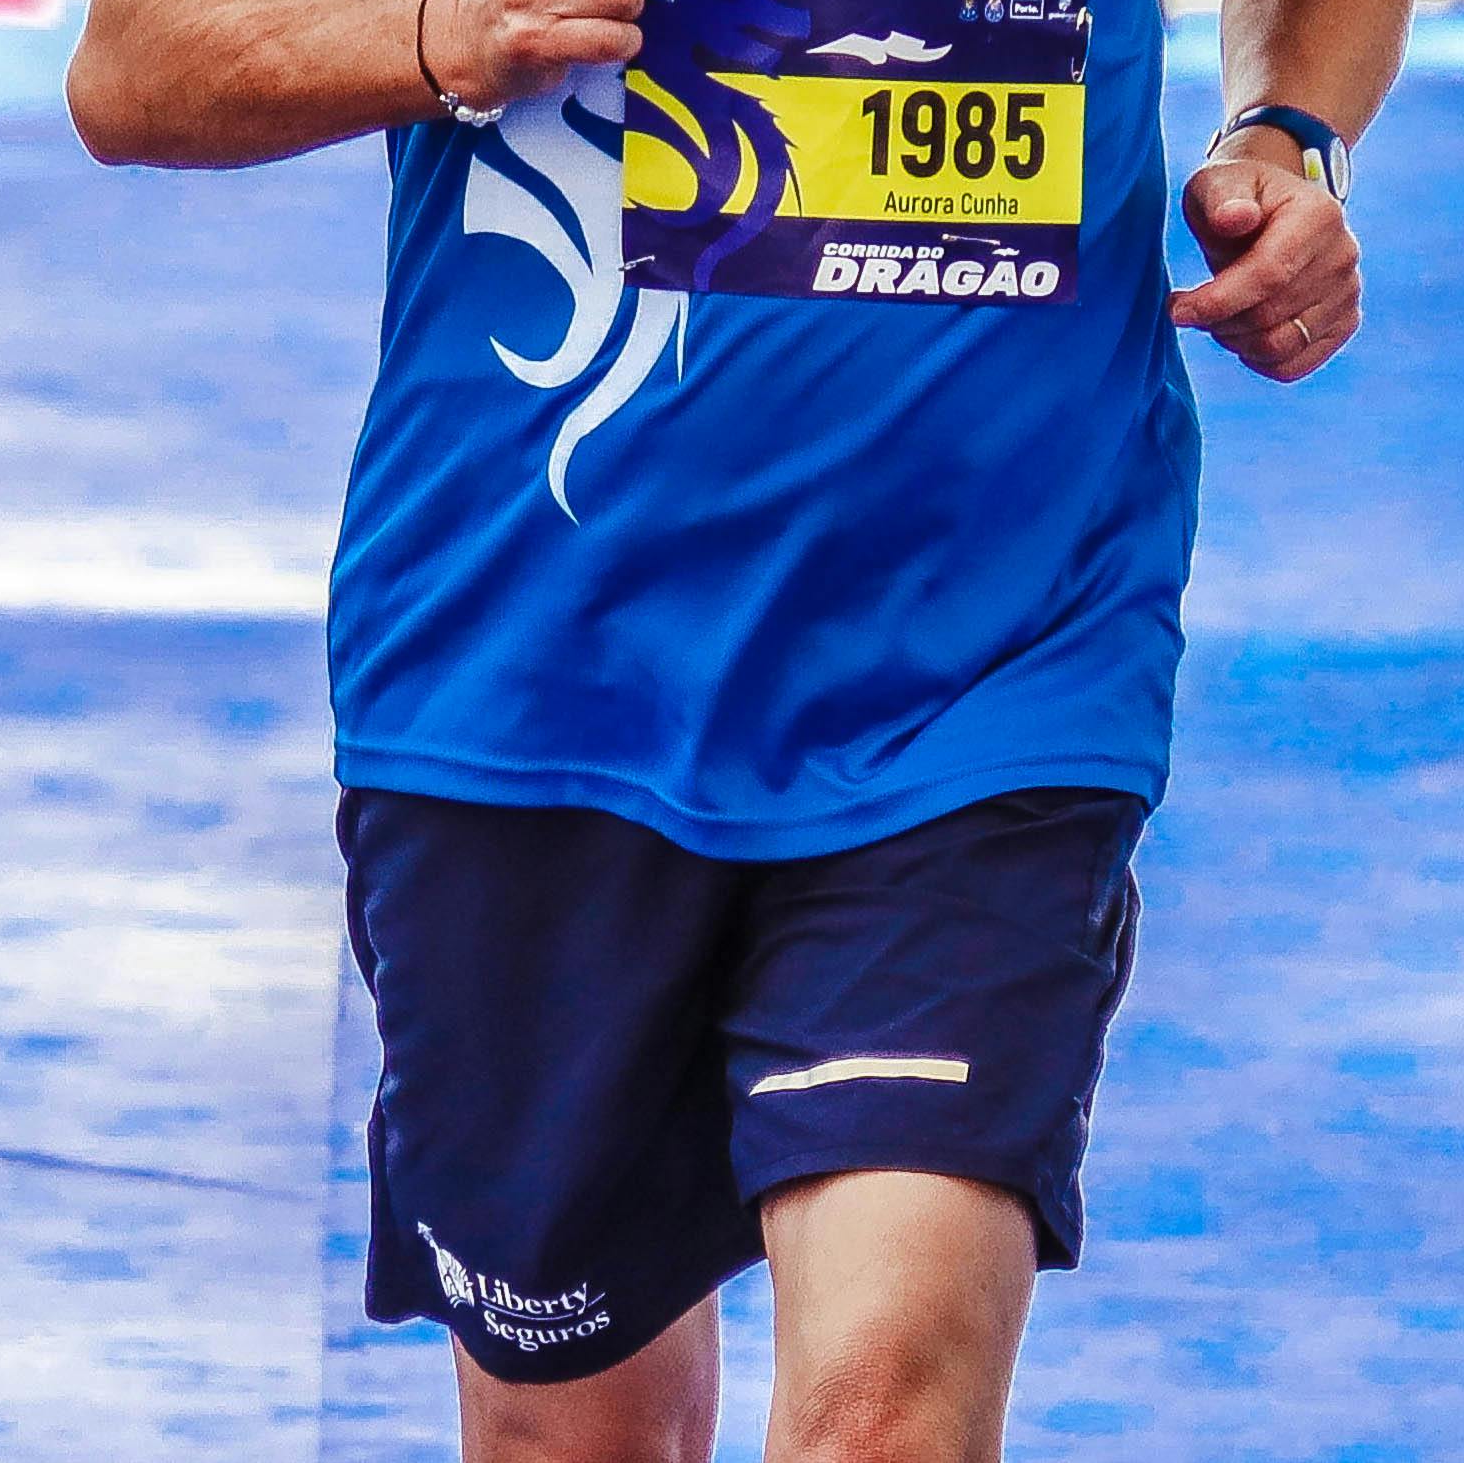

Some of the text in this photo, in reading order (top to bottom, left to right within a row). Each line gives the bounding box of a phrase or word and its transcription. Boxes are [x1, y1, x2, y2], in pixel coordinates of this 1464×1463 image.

[861, 88, 1047, 180] 1985
[883, 190, 1019, 216] Aurora Cunha
[812, 247, 1060, 298] DRAGÃO
[823, 242, 945, 260] CORRIDA DO
[476, 1272, 587, 1316] Liberty
[483, 1309, 611, 1352] Seguros
